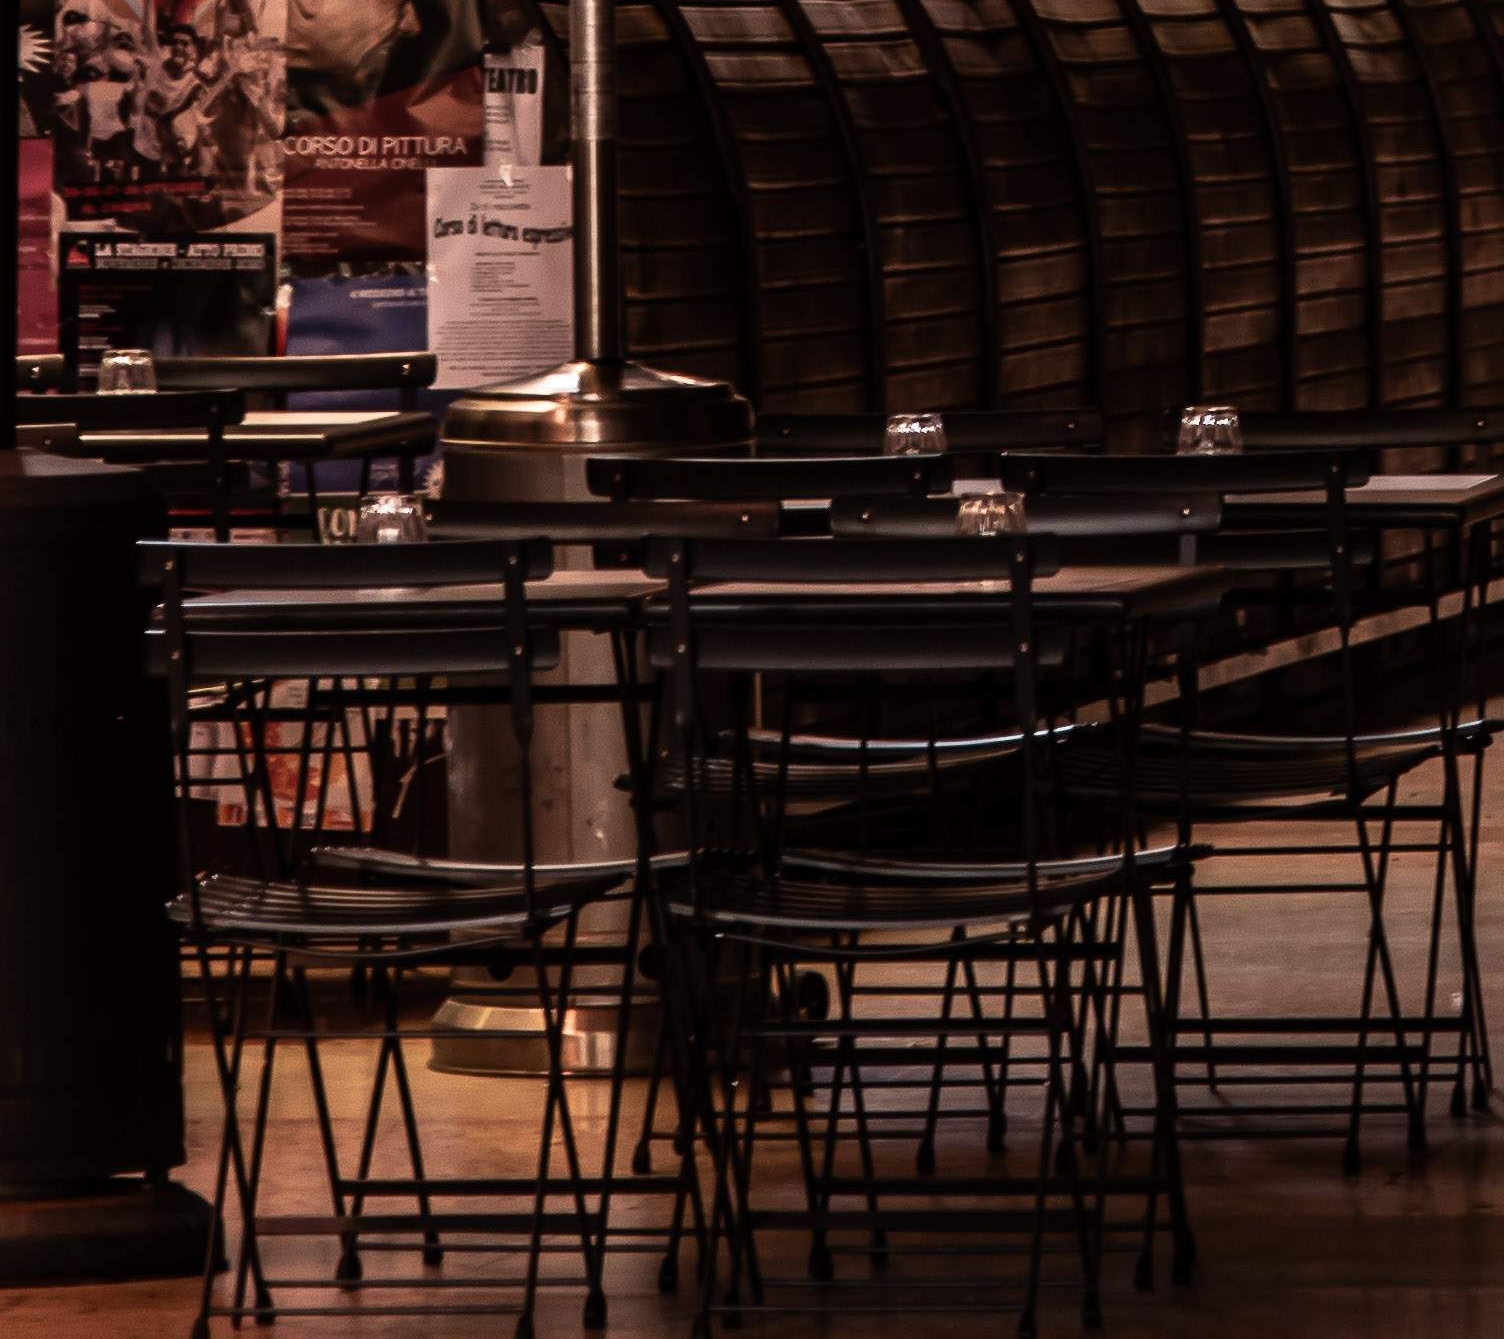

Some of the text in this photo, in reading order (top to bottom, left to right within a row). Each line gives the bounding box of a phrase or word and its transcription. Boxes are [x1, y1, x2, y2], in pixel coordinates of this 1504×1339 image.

[283, 137, 468, 156] CORSO DI PITTURA
